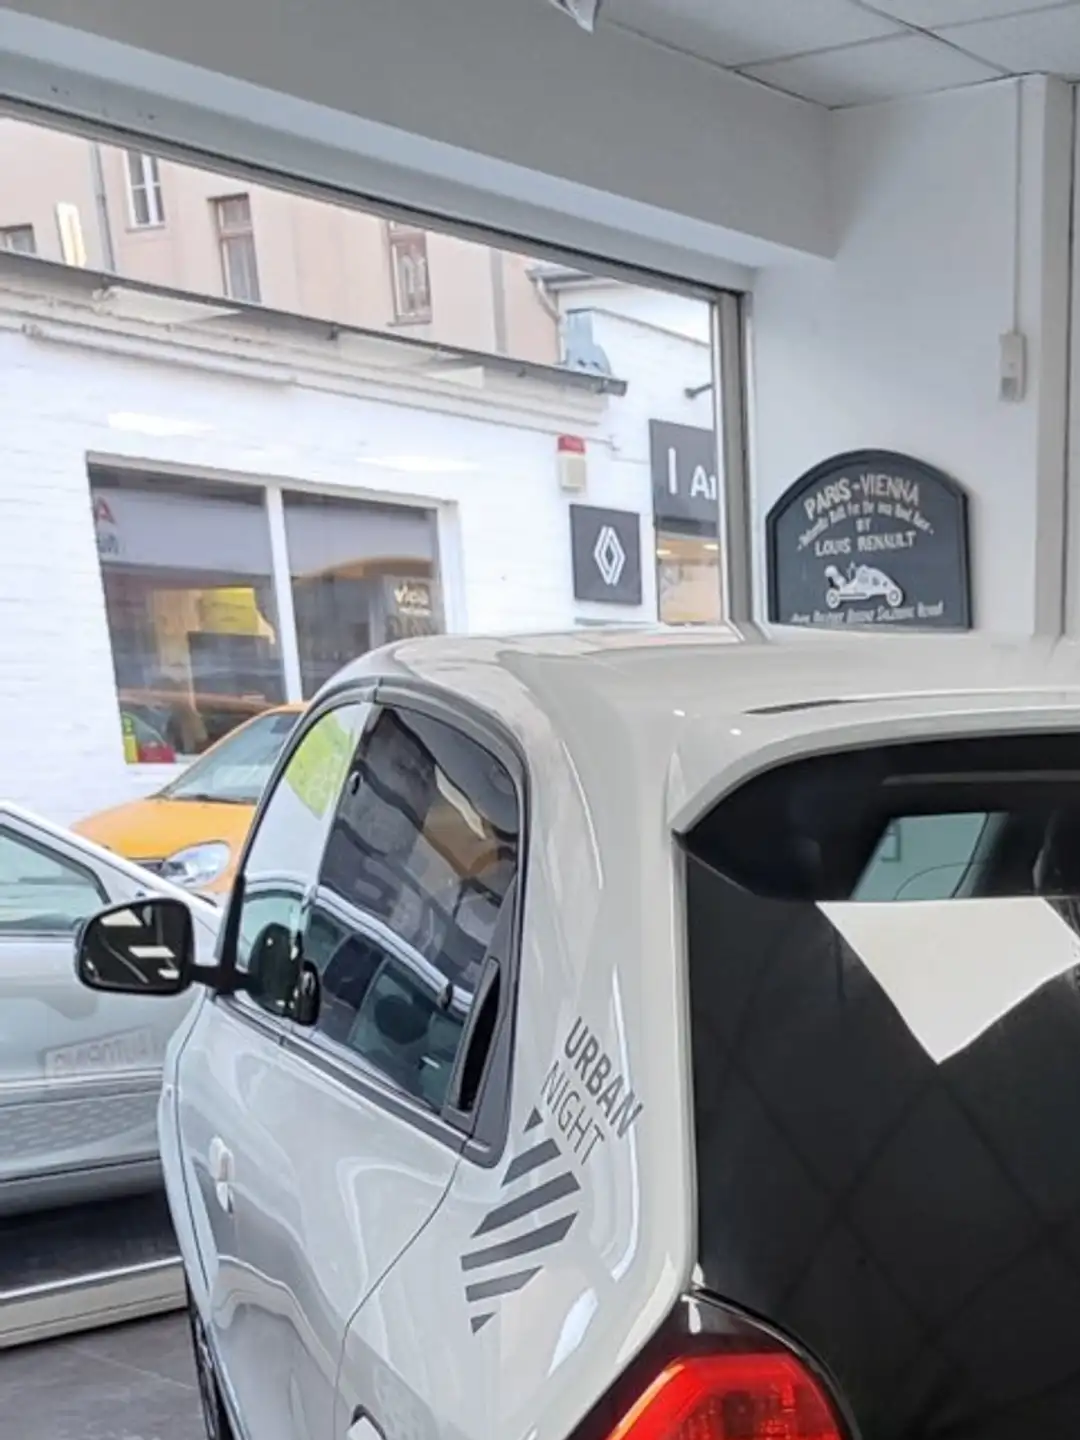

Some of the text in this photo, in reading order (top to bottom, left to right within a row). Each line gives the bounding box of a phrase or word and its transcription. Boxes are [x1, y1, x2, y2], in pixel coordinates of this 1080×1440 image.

[814, 531, 917, 557] LOUIS RENAULT
[540, 1060, 606, 1166] NIGHT
[564, 1015, 644, 1139] URBAN
